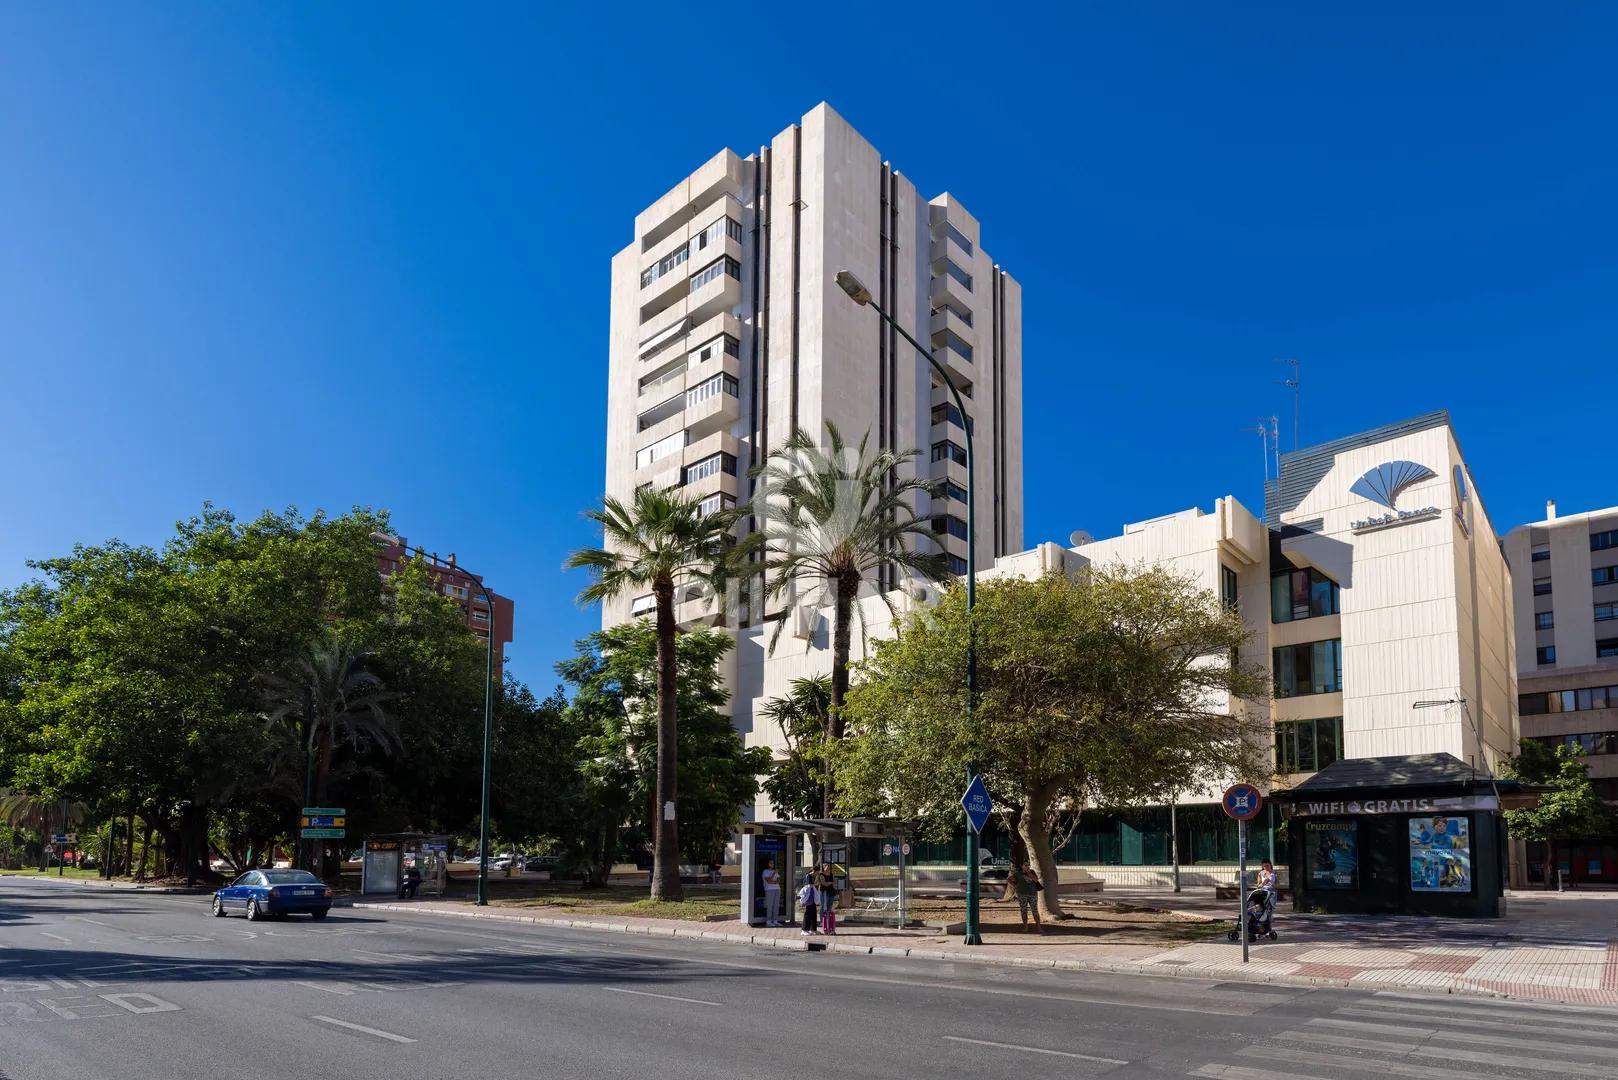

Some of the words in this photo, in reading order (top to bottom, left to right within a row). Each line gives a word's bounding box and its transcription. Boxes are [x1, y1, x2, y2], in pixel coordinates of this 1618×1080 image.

[1350, 513, 1393, 529] Unicaja
[1398, 505, 1435, 519] Banco
[972, 794, 984, 803] RED
[1309, 802, 1345, 815] WiFi
[1364, 799, 1429, 814] GRATIS
[991, 857, 1010, 865] Unic
